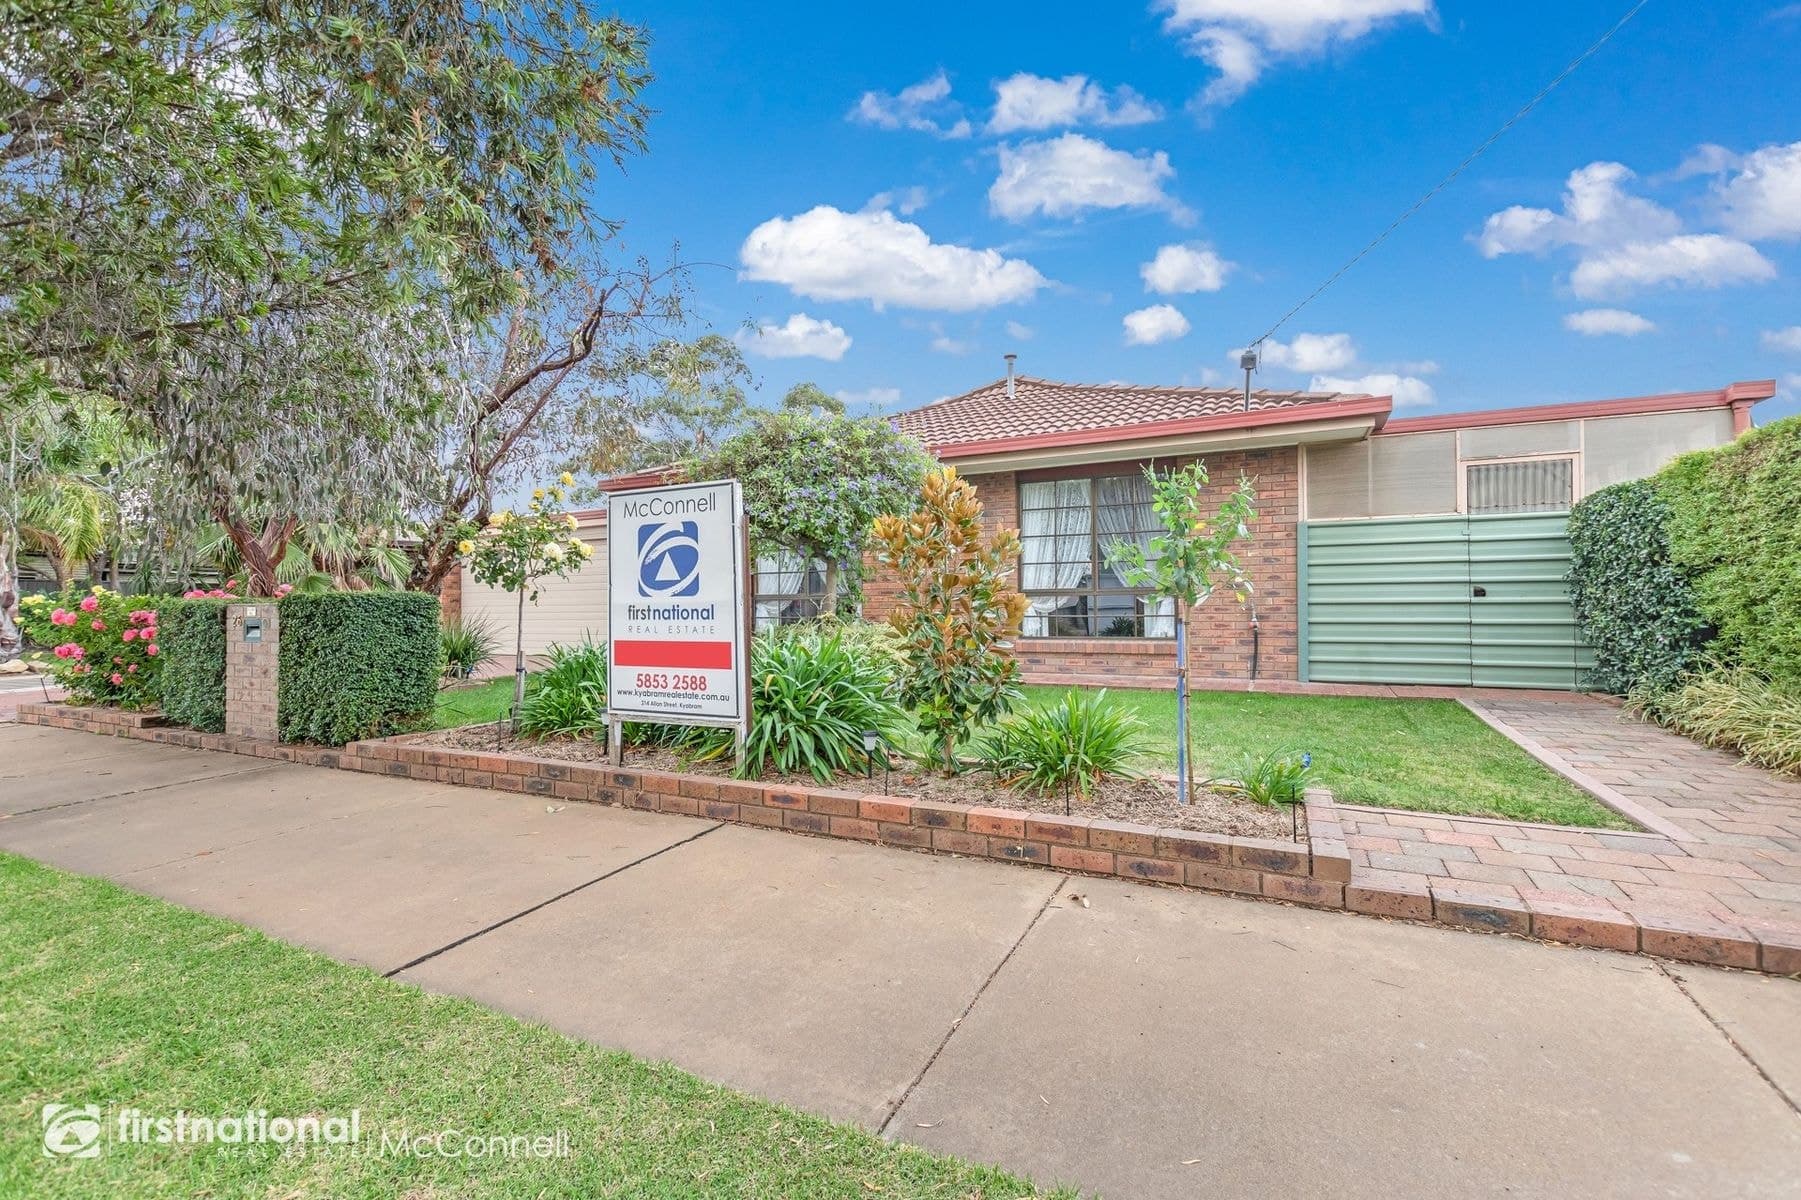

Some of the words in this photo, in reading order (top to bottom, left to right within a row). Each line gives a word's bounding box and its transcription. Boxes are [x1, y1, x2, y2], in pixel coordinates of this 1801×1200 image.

[623, 492, 716, 518] McConnell
[628, 625, 658, 634] REAL
[668, 625, 715, 634] ESTATE
[636, 673, 668, 689] 5853
[672, 675, 707, 691] 2588
[617, 688, 730, 702] www.kyabramrealestate.com.au
